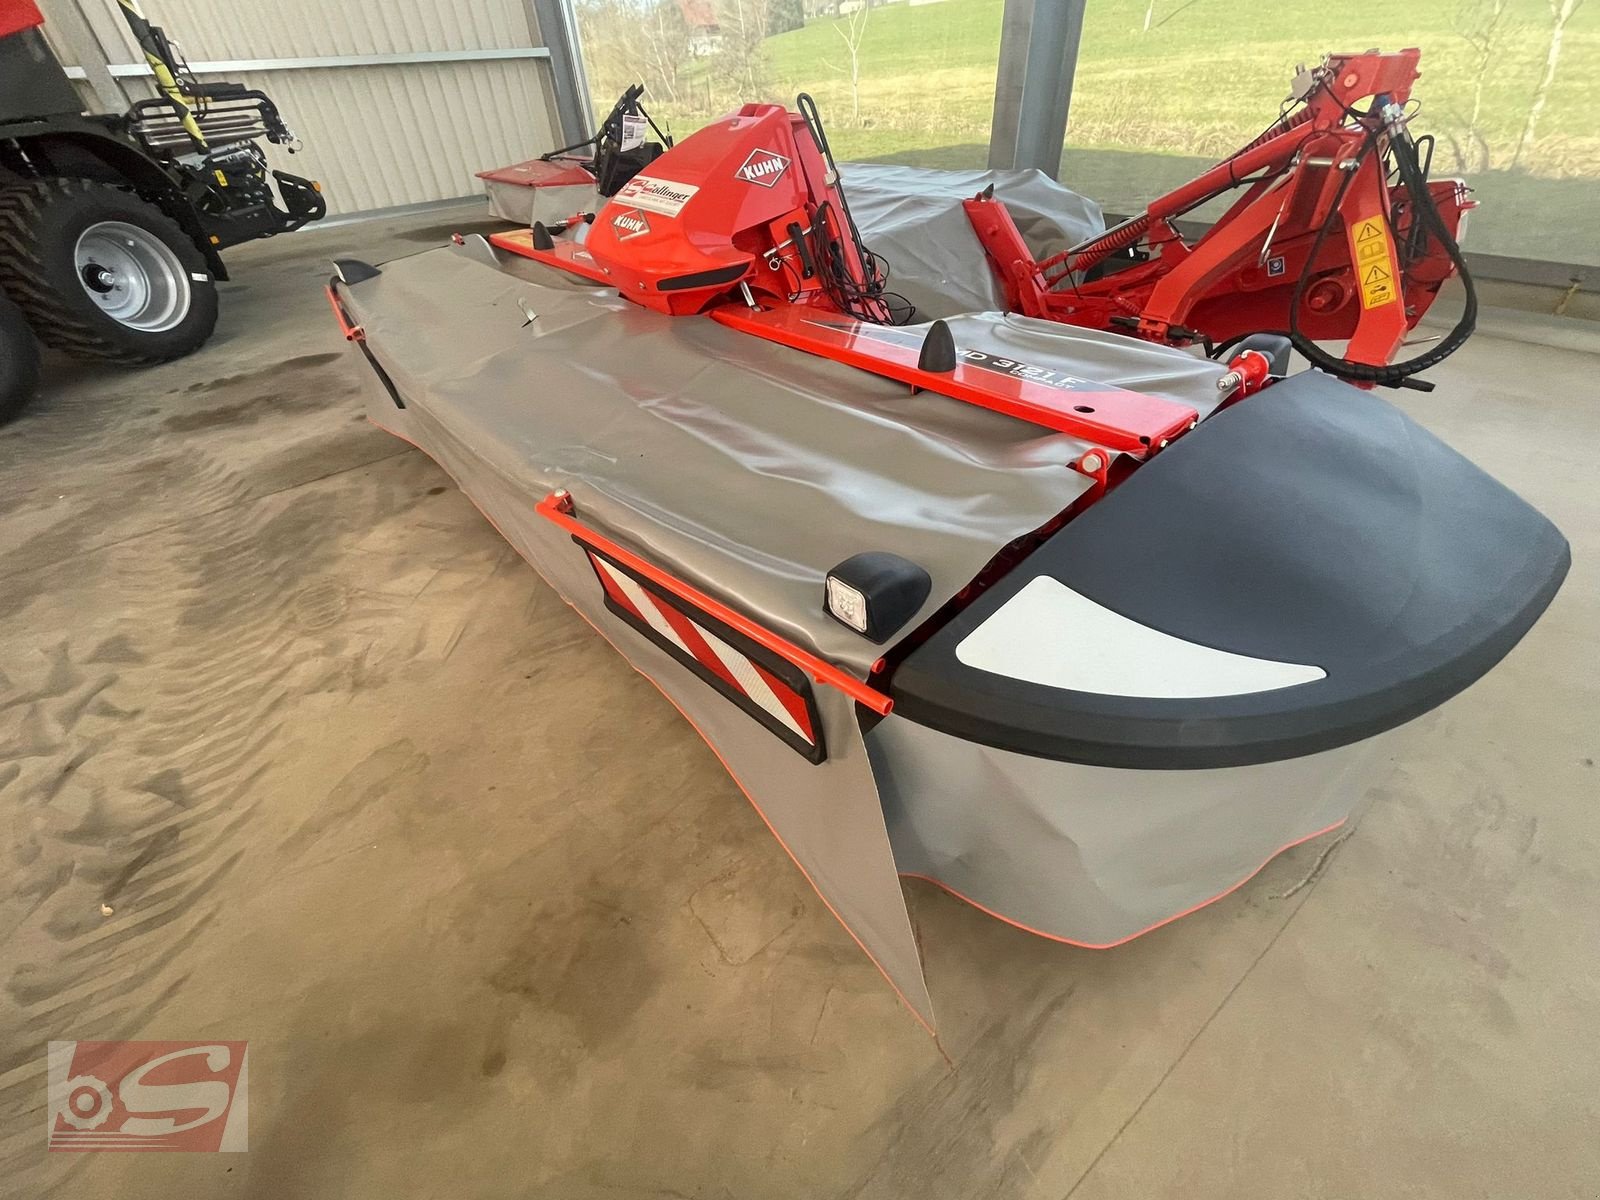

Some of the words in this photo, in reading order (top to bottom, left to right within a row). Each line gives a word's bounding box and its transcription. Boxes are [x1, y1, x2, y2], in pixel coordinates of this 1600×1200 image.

[743, 157, 785, 180] KUHN
[614, 215, 645, 233] KUHN
[992, 359, 1057, 378] 3121
[1060, 376, 1087, 386] F
[1009, 370, 1075, 389] COMPACT
